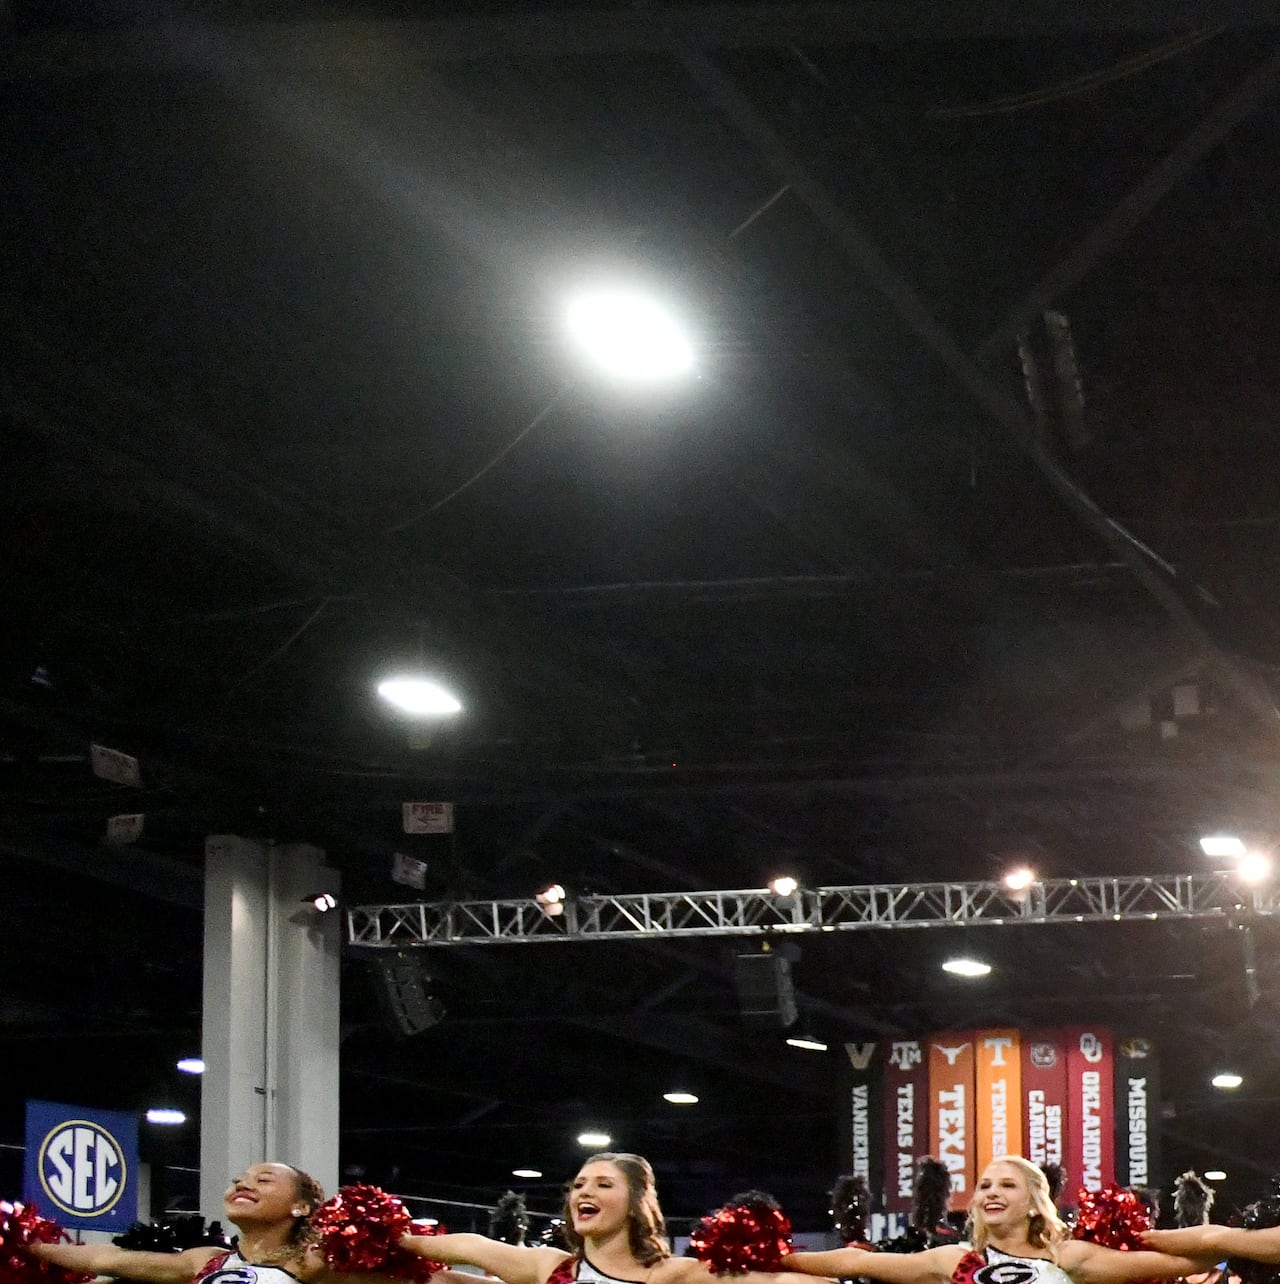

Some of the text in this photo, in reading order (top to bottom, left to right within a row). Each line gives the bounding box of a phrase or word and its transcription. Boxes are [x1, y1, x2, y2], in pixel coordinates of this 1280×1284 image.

[845, 1043, 876, 1070] V
[898, 1083, 914, 1148] TEXAS
[938, 1084, 966, 1193] TEXAS
[991, 1079, 1007, 1160] TENNES
[1082, 1071, 1102, 1193] OKLAHOMA
[1128, 1077, 1148, 1185] MISSOURI
[47, 1127, 119, 1209] SEC
